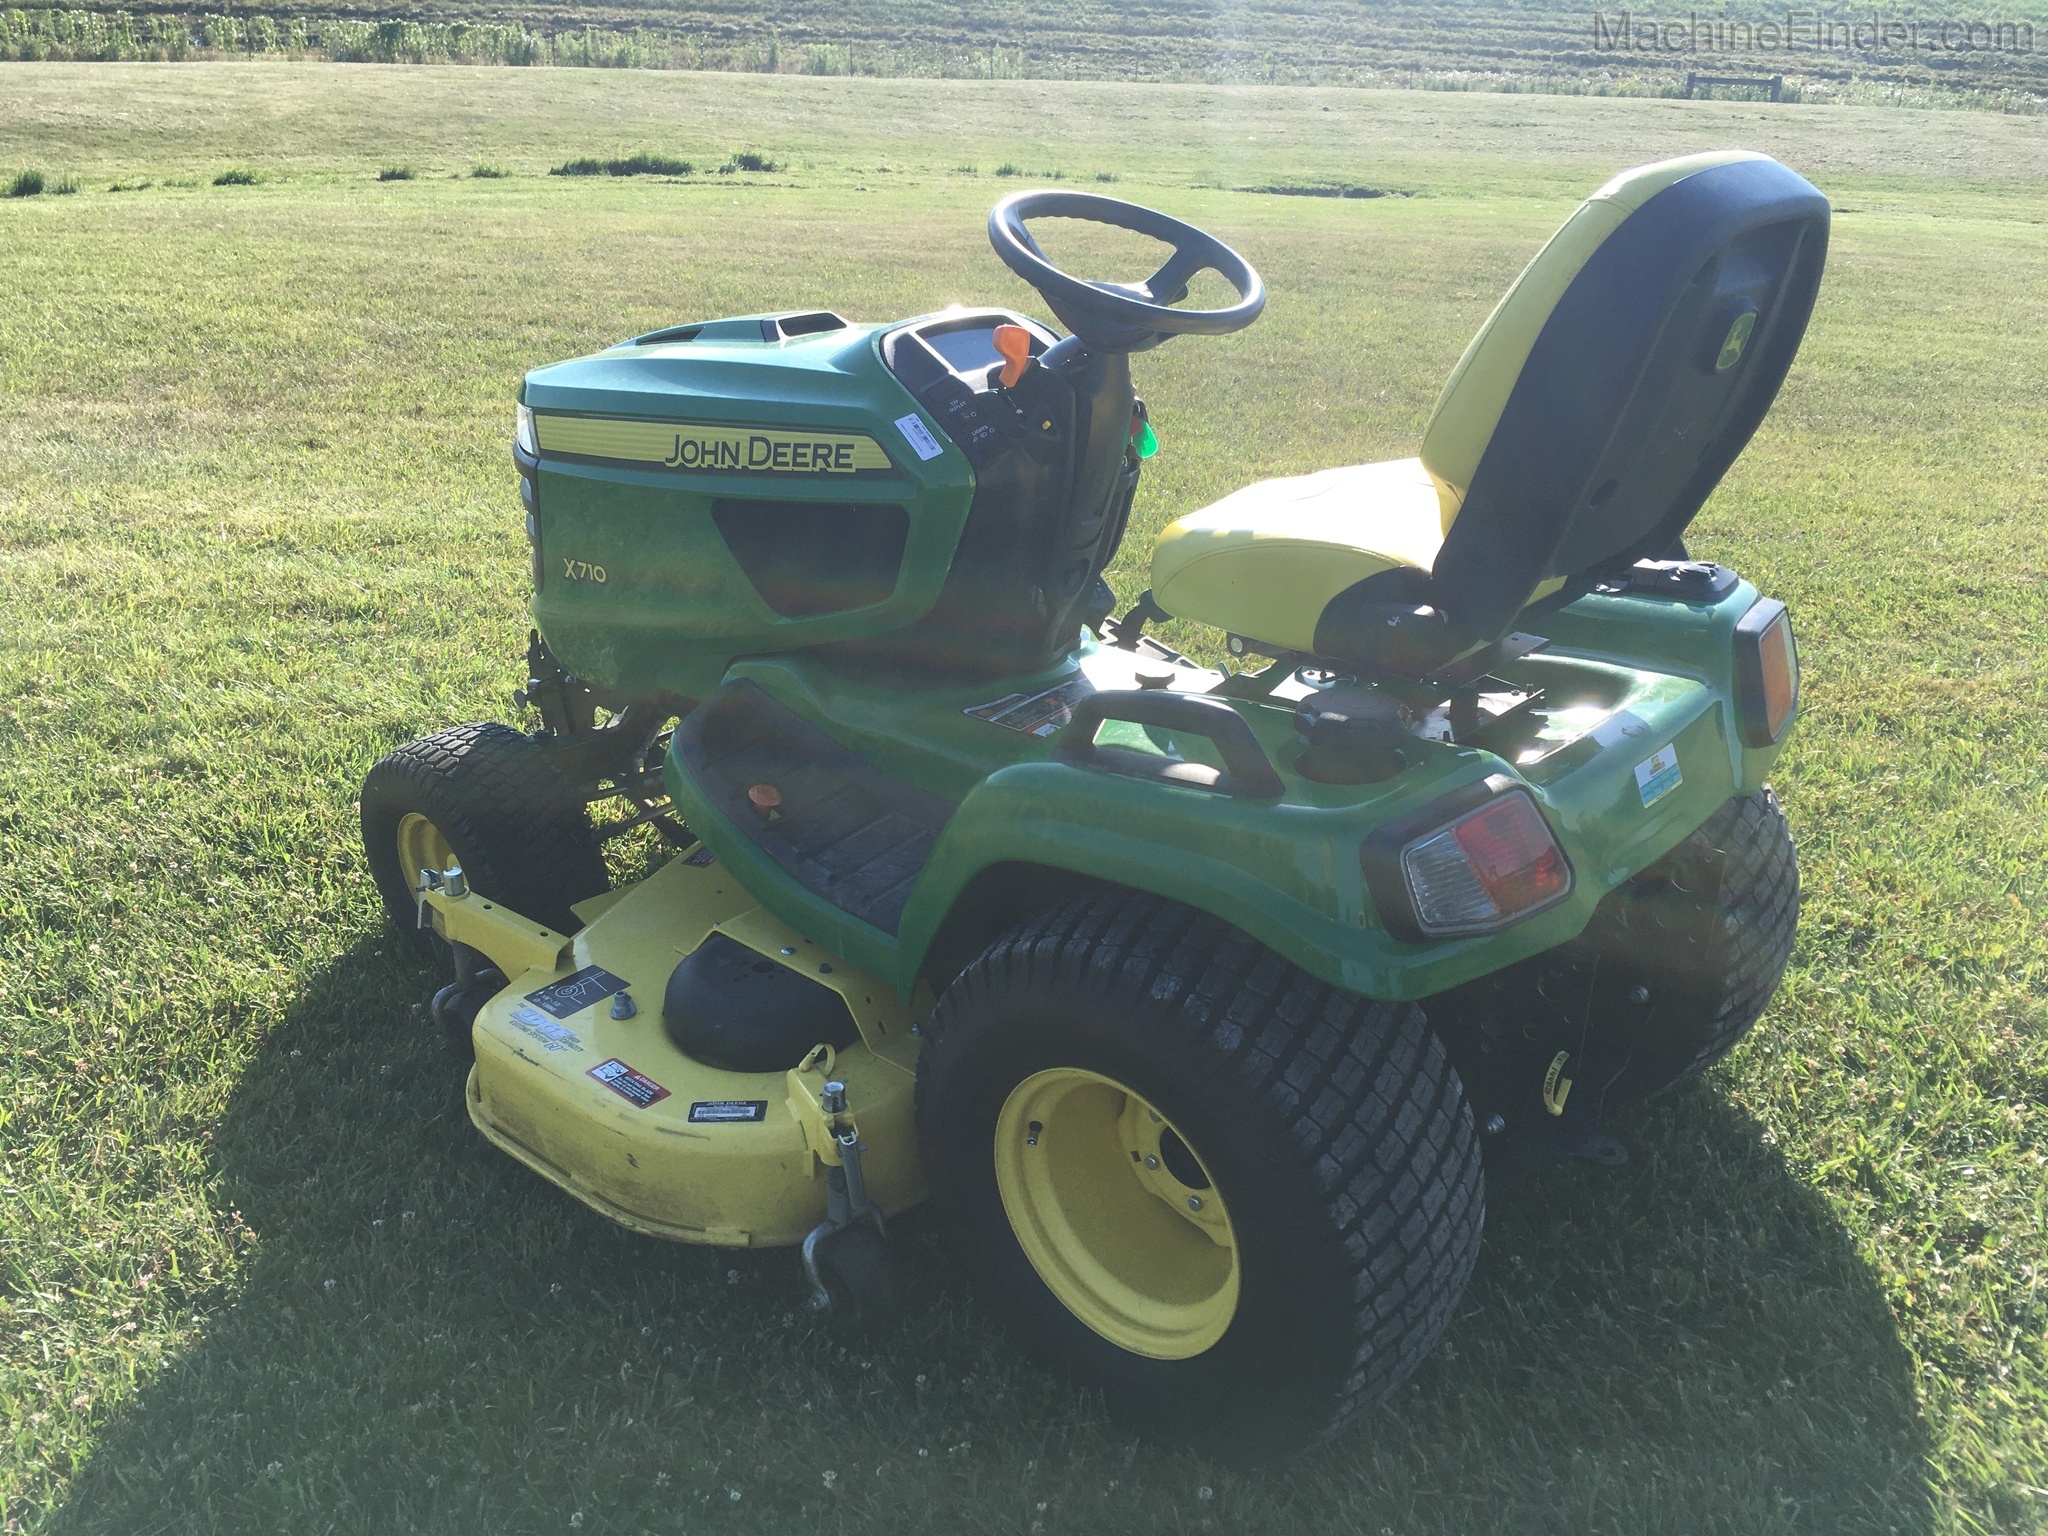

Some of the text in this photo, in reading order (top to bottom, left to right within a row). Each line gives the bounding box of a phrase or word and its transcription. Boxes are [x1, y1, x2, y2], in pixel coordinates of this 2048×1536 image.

[949, 401, 967, 413] OUTLET
[665, 434, 856, 471] JOHN DEERE
[562, 557, 607, 584] X710
[509, 1008, 575, 1041] EDGE
[639, 1077, 661, 1091] DANGER
